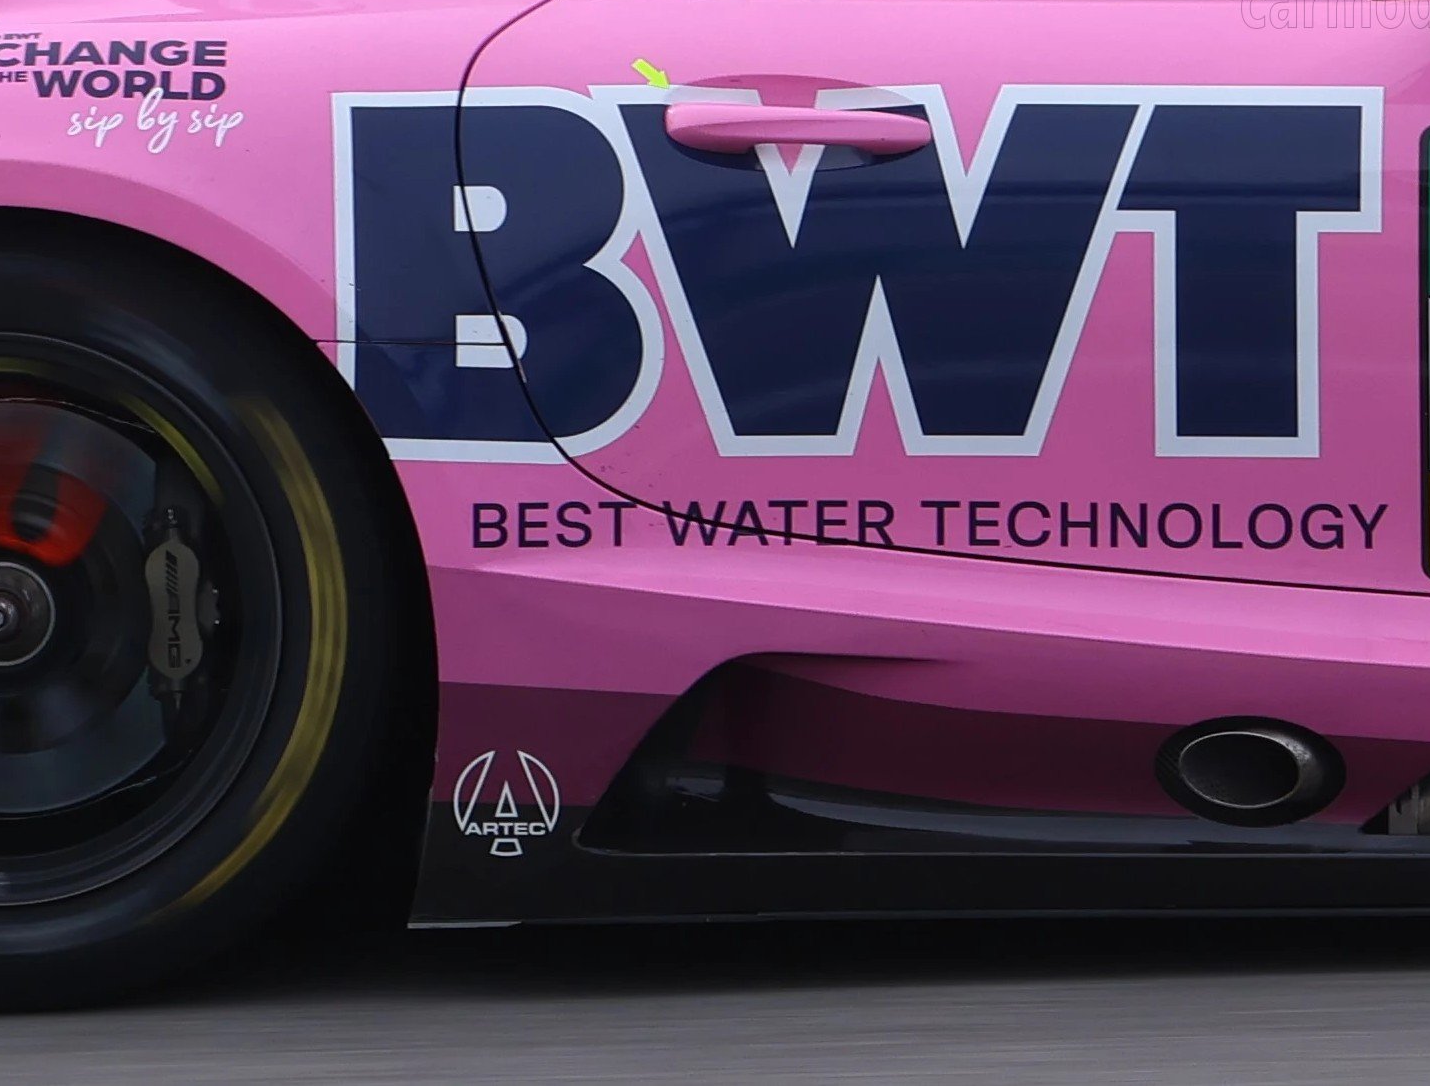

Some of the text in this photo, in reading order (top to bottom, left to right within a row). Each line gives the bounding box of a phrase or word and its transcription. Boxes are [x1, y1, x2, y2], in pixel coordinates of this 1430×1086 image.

[32, 69, 226, 101] WORLD
[67, 87, 244, 154] sip by sip
[331, 84, 1385, 463] BWT
[471, 499, 1387, 550] BEST WATER TECHNOLOGY
[463, 821, 547, 835] ARTEC
